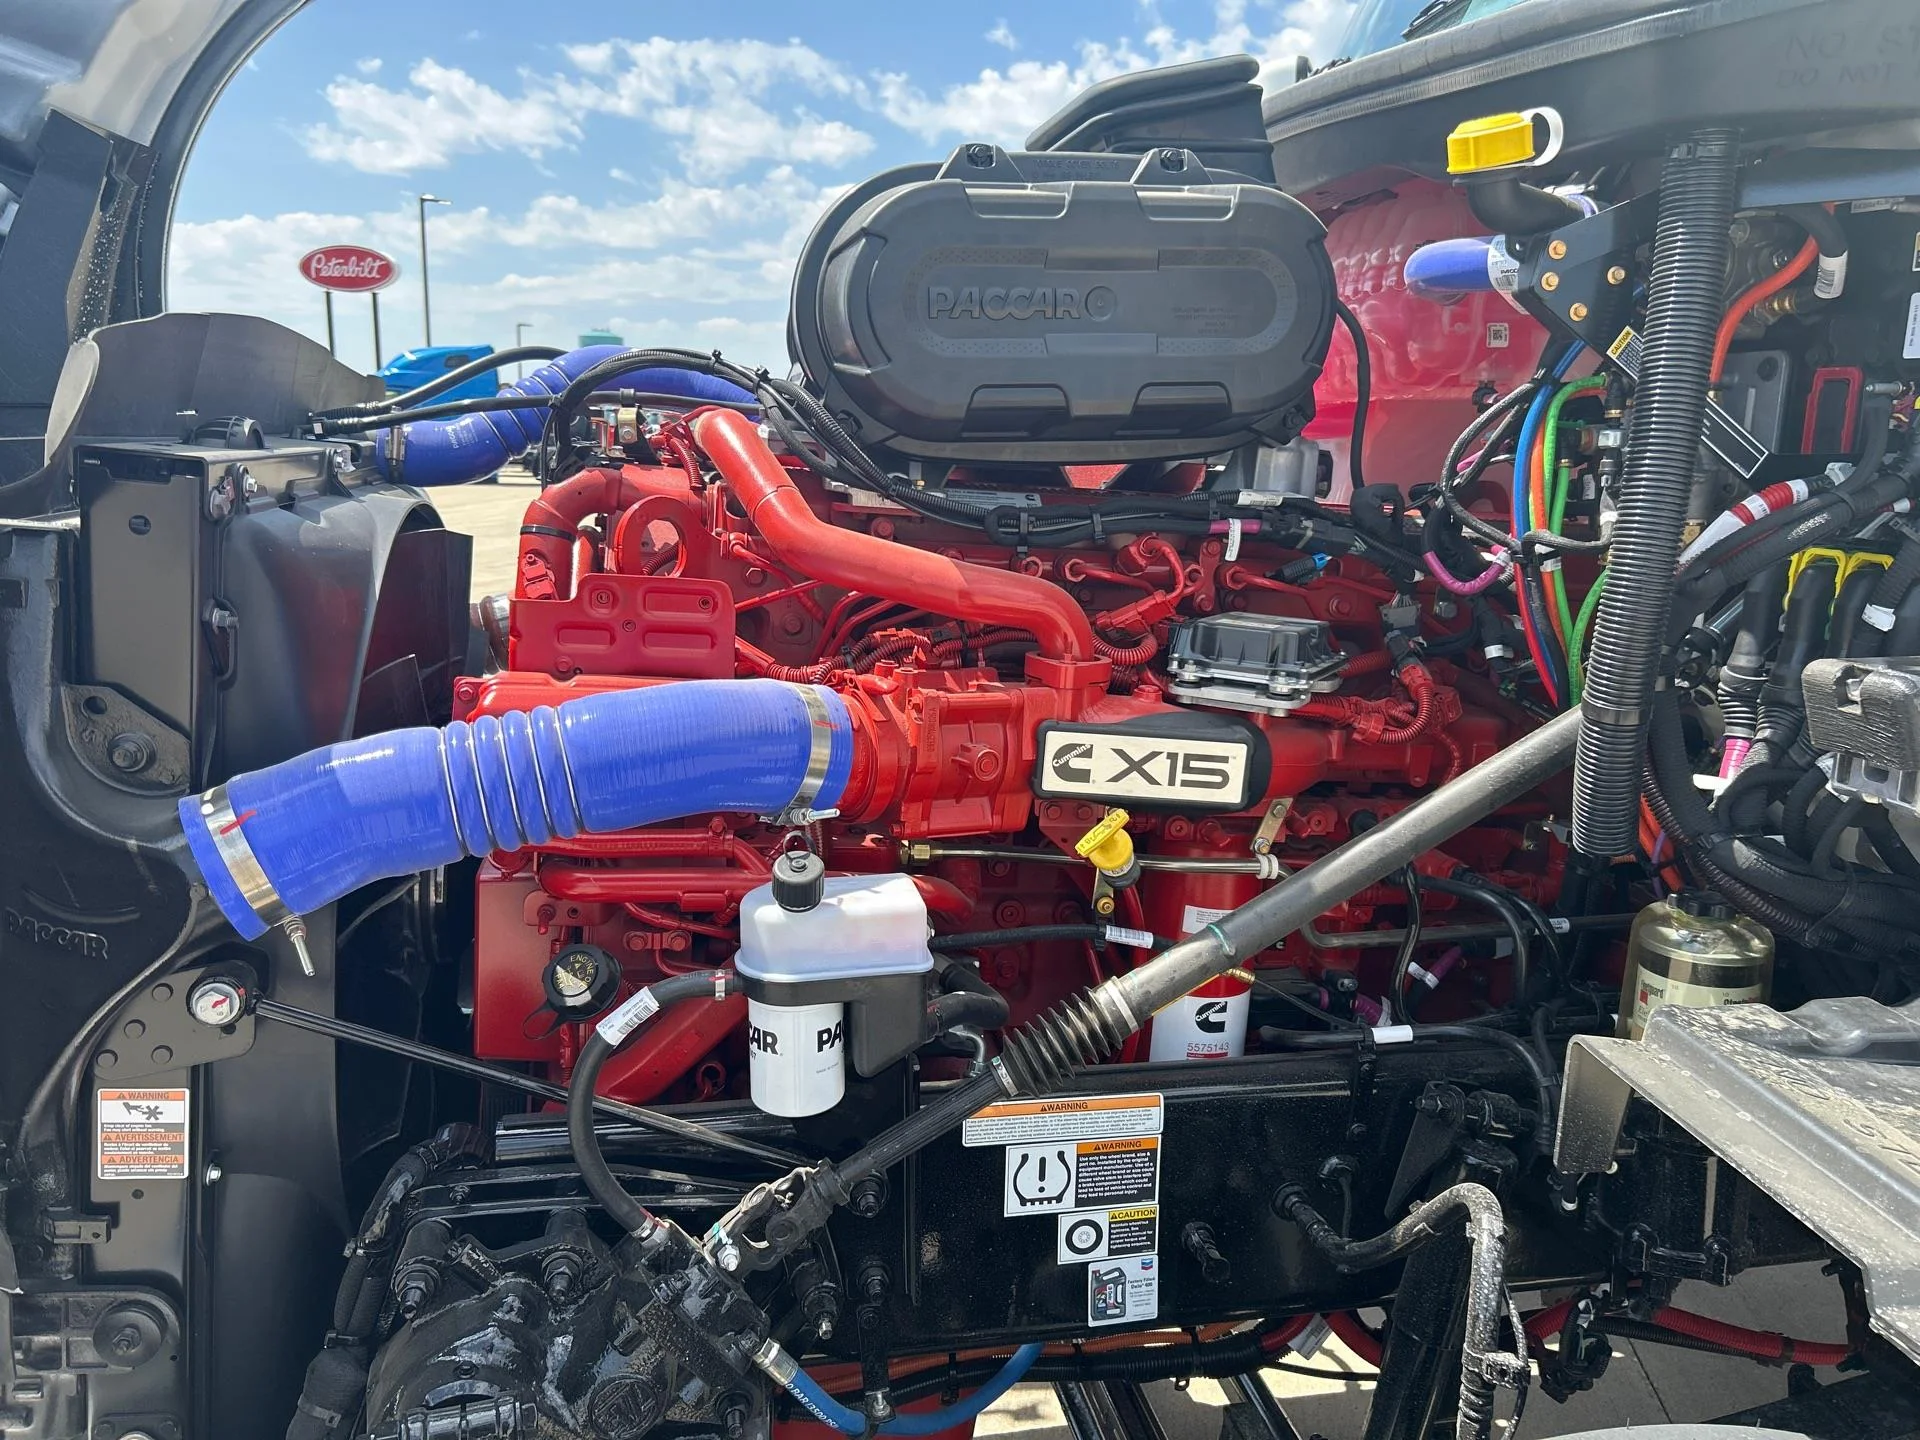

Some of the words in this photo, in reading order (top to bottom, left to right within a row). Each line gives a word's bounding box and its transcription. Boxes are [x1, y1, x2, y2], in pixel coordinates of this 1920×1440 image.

[311, 253, 387, 279] Peterbilt
[927, 286, 1081, 320] PACCAR
[1610, 329, 1634, 356] CAUTION
[1052, 743, 1091, 768] Cummins
[1104, 747, 1231, 790] X15
[5, 906, 108, 960] PACCAR
[570, 954, 594, 975] ENGINE
[1195, 1001, 1226, 1022] Cummins
[1187, 1041, 1230, 1053] 5575143
[1046, 1101, 1088, 1112] WARNING
[1101, 1141, 1141, 1150] WARNING
[1118, 1209, 1156, 1219] CAUTION
